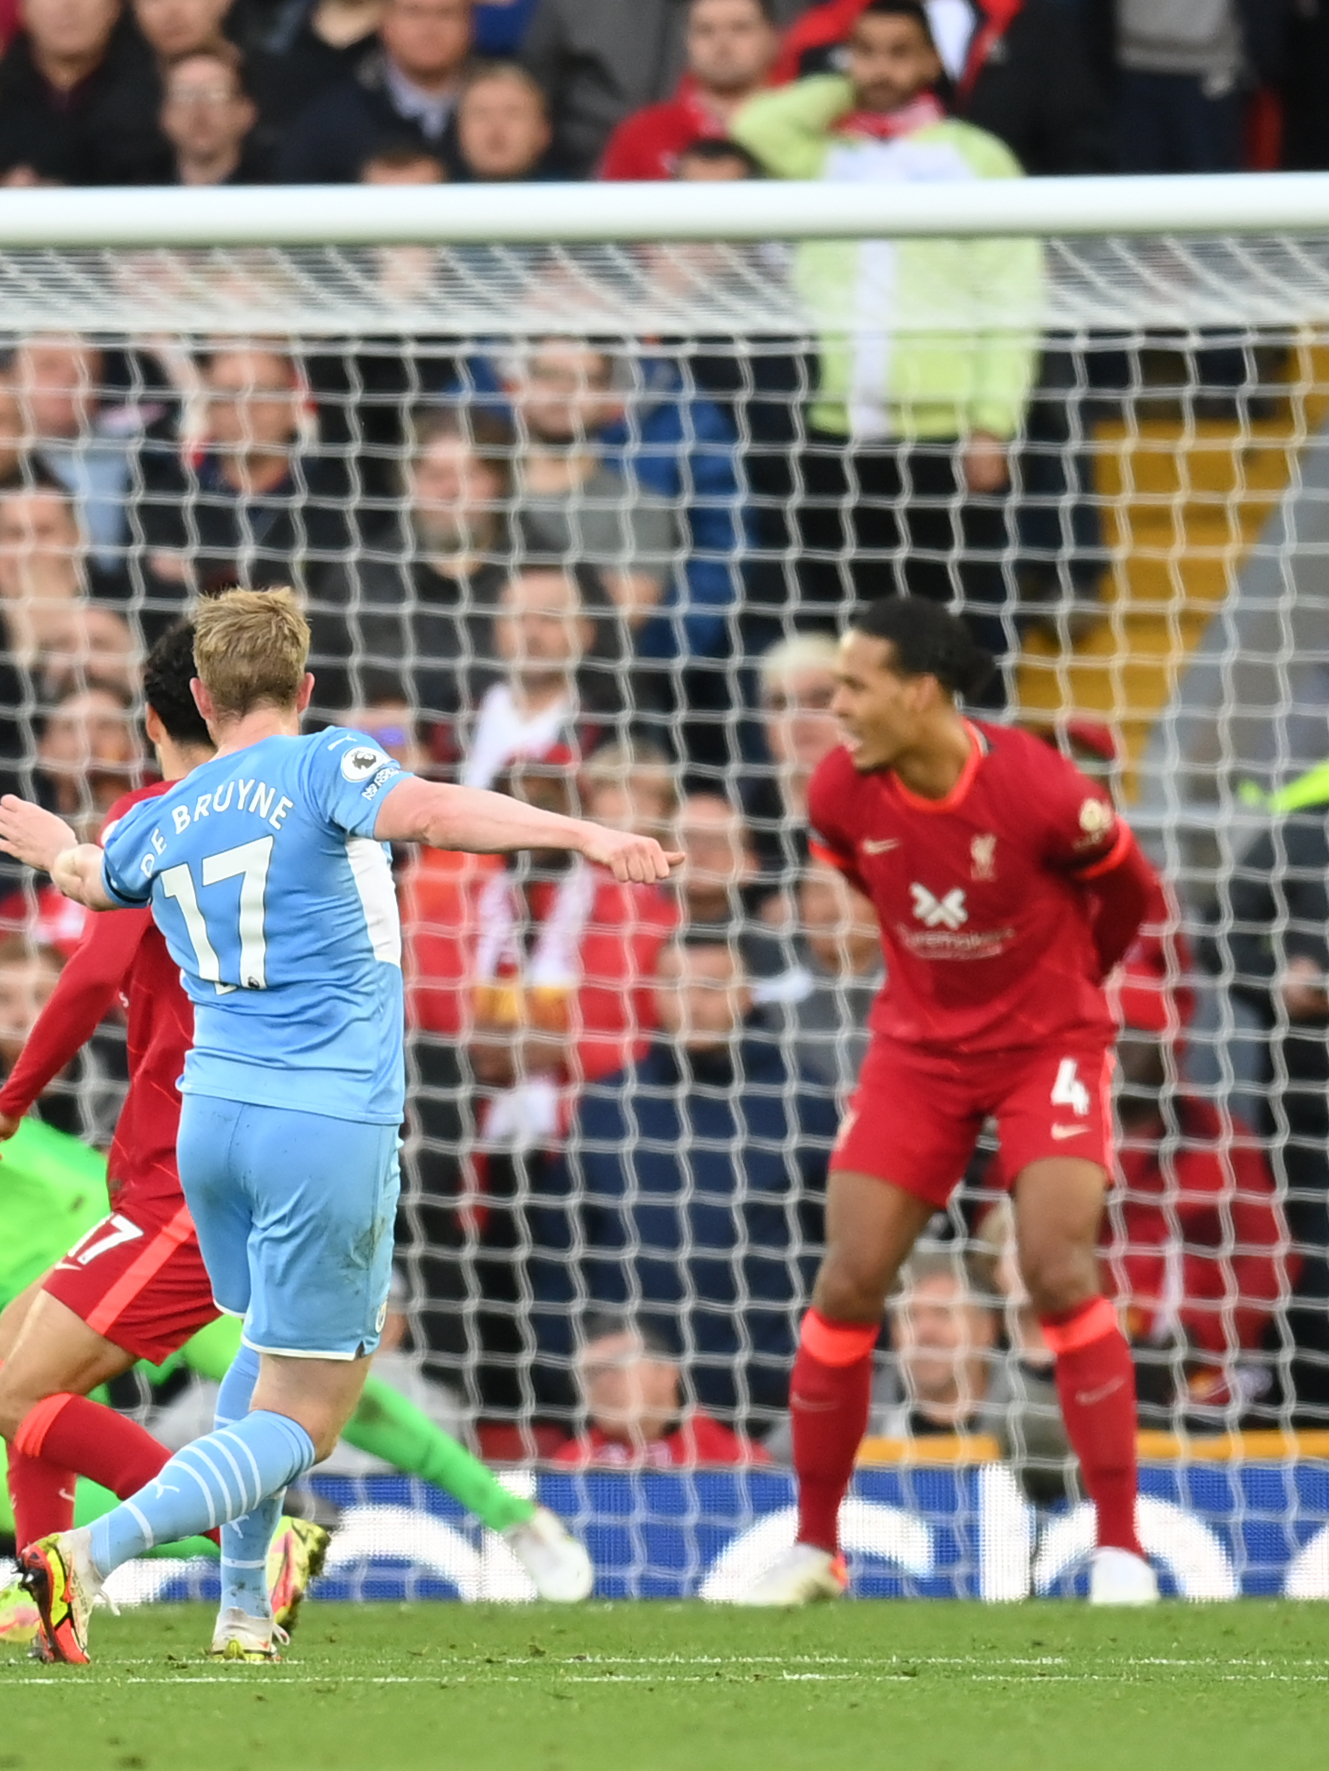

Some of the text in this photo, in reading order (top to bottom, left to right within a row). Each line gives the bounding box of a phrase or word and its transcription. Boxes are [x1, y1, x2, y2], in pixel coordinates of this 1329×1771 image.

[141, 779, 294, 878] DE BRUYNE
[160, 835, 274, 994] 17
[1050, 1057, 1091, 1117] 4
